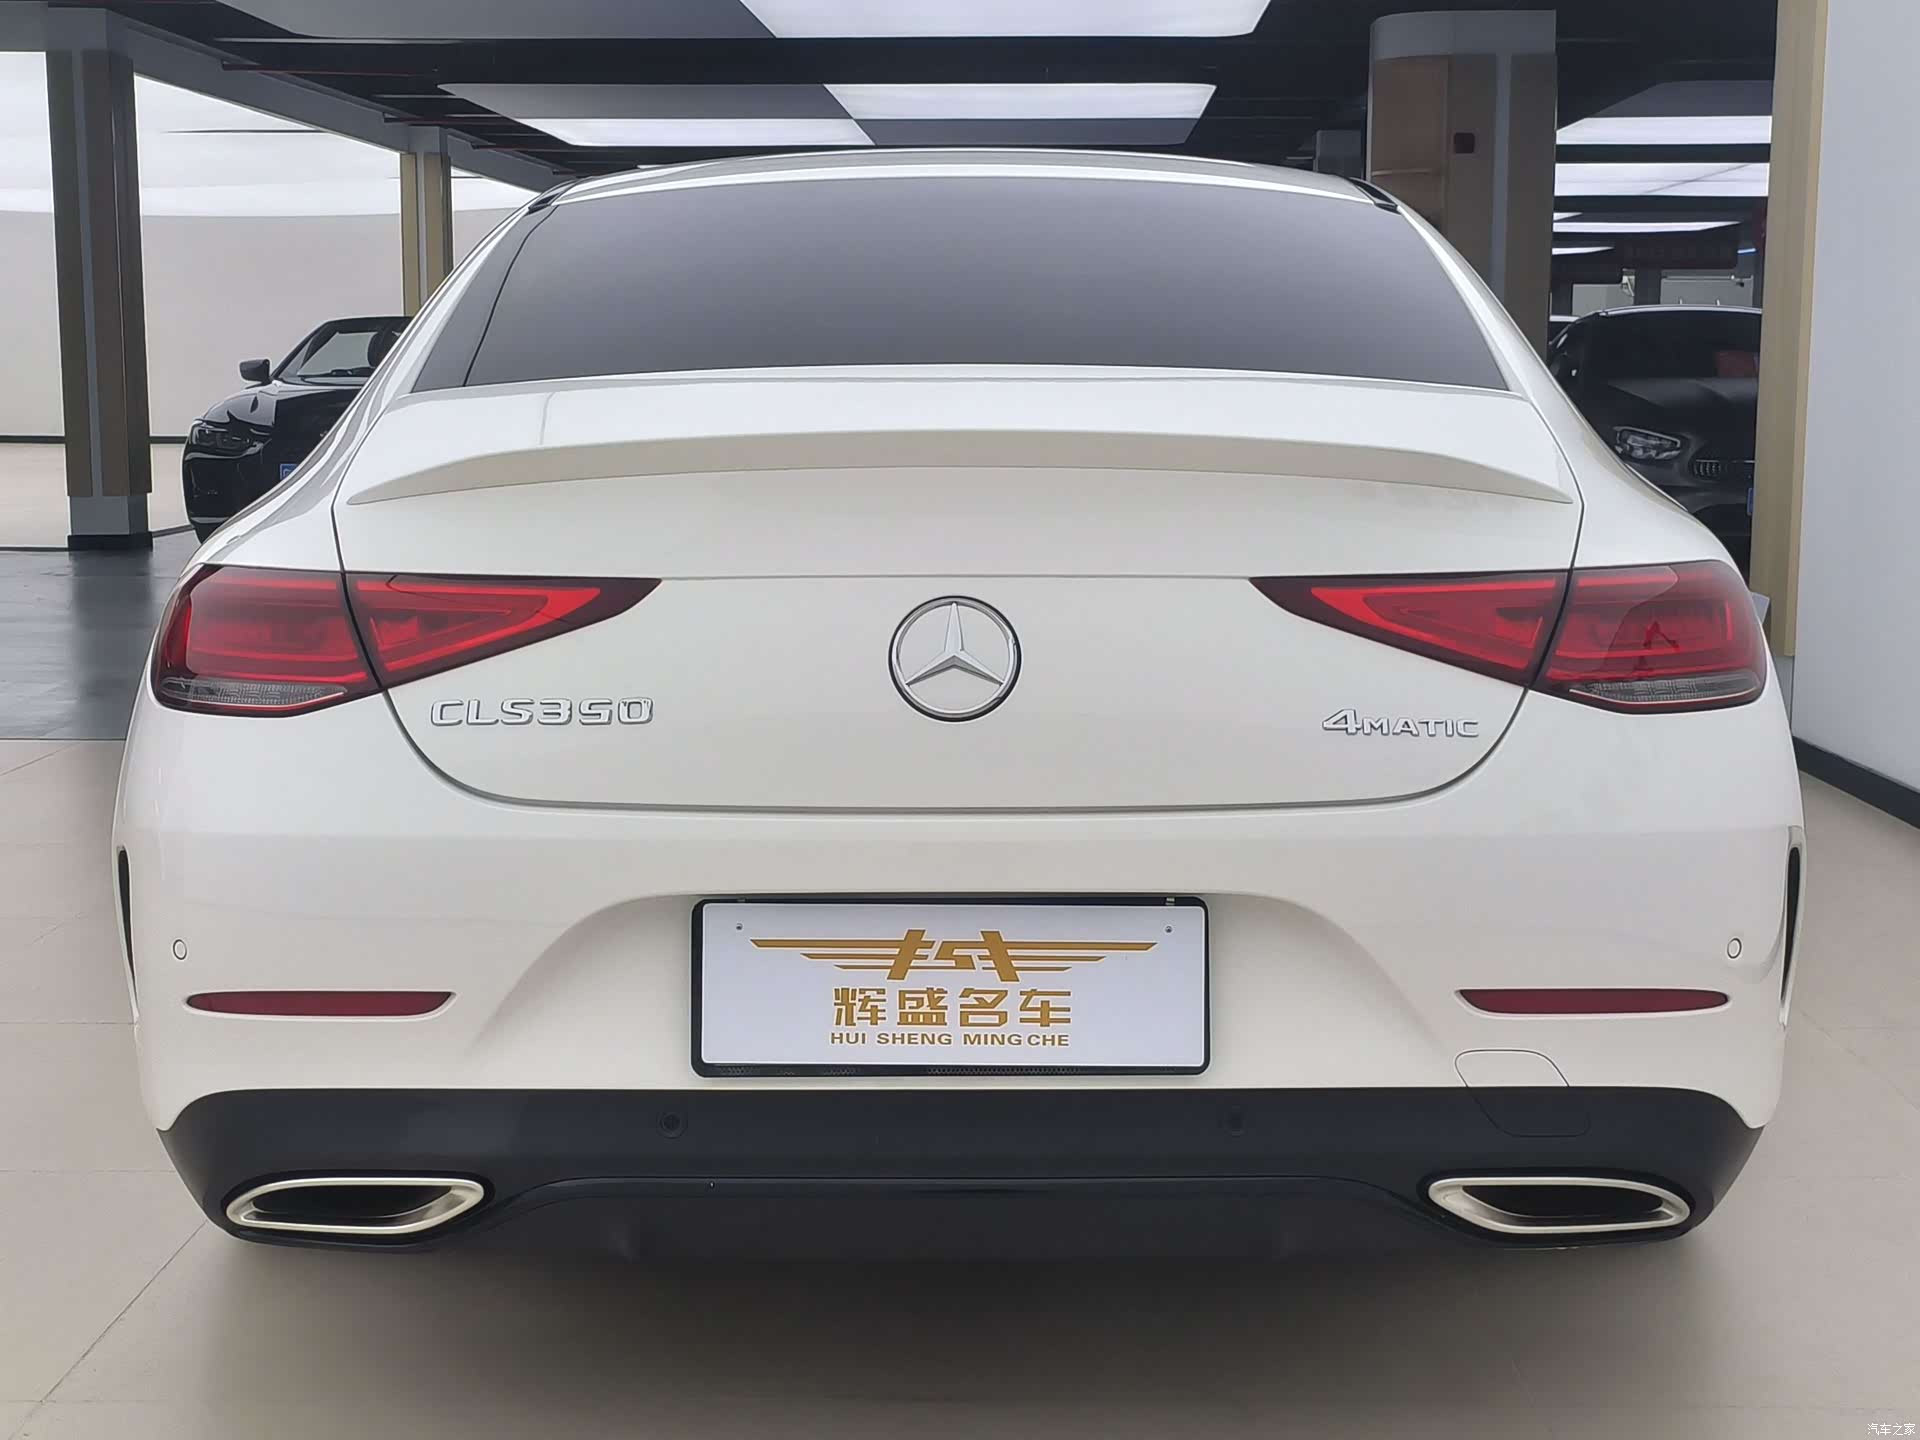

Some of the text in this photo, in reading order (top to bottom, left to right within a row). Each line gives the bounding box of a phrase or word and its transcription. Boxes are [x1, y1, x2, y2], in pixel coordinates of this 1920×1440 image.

[431, 697, 653, 726] CLS350
[1322, 708, 1479, 738] 4MATIC
[833, 987, 1072, 1027] 辉盛名车
[830, 1032, 1070, 1047] HUI SHENG MING CHE
